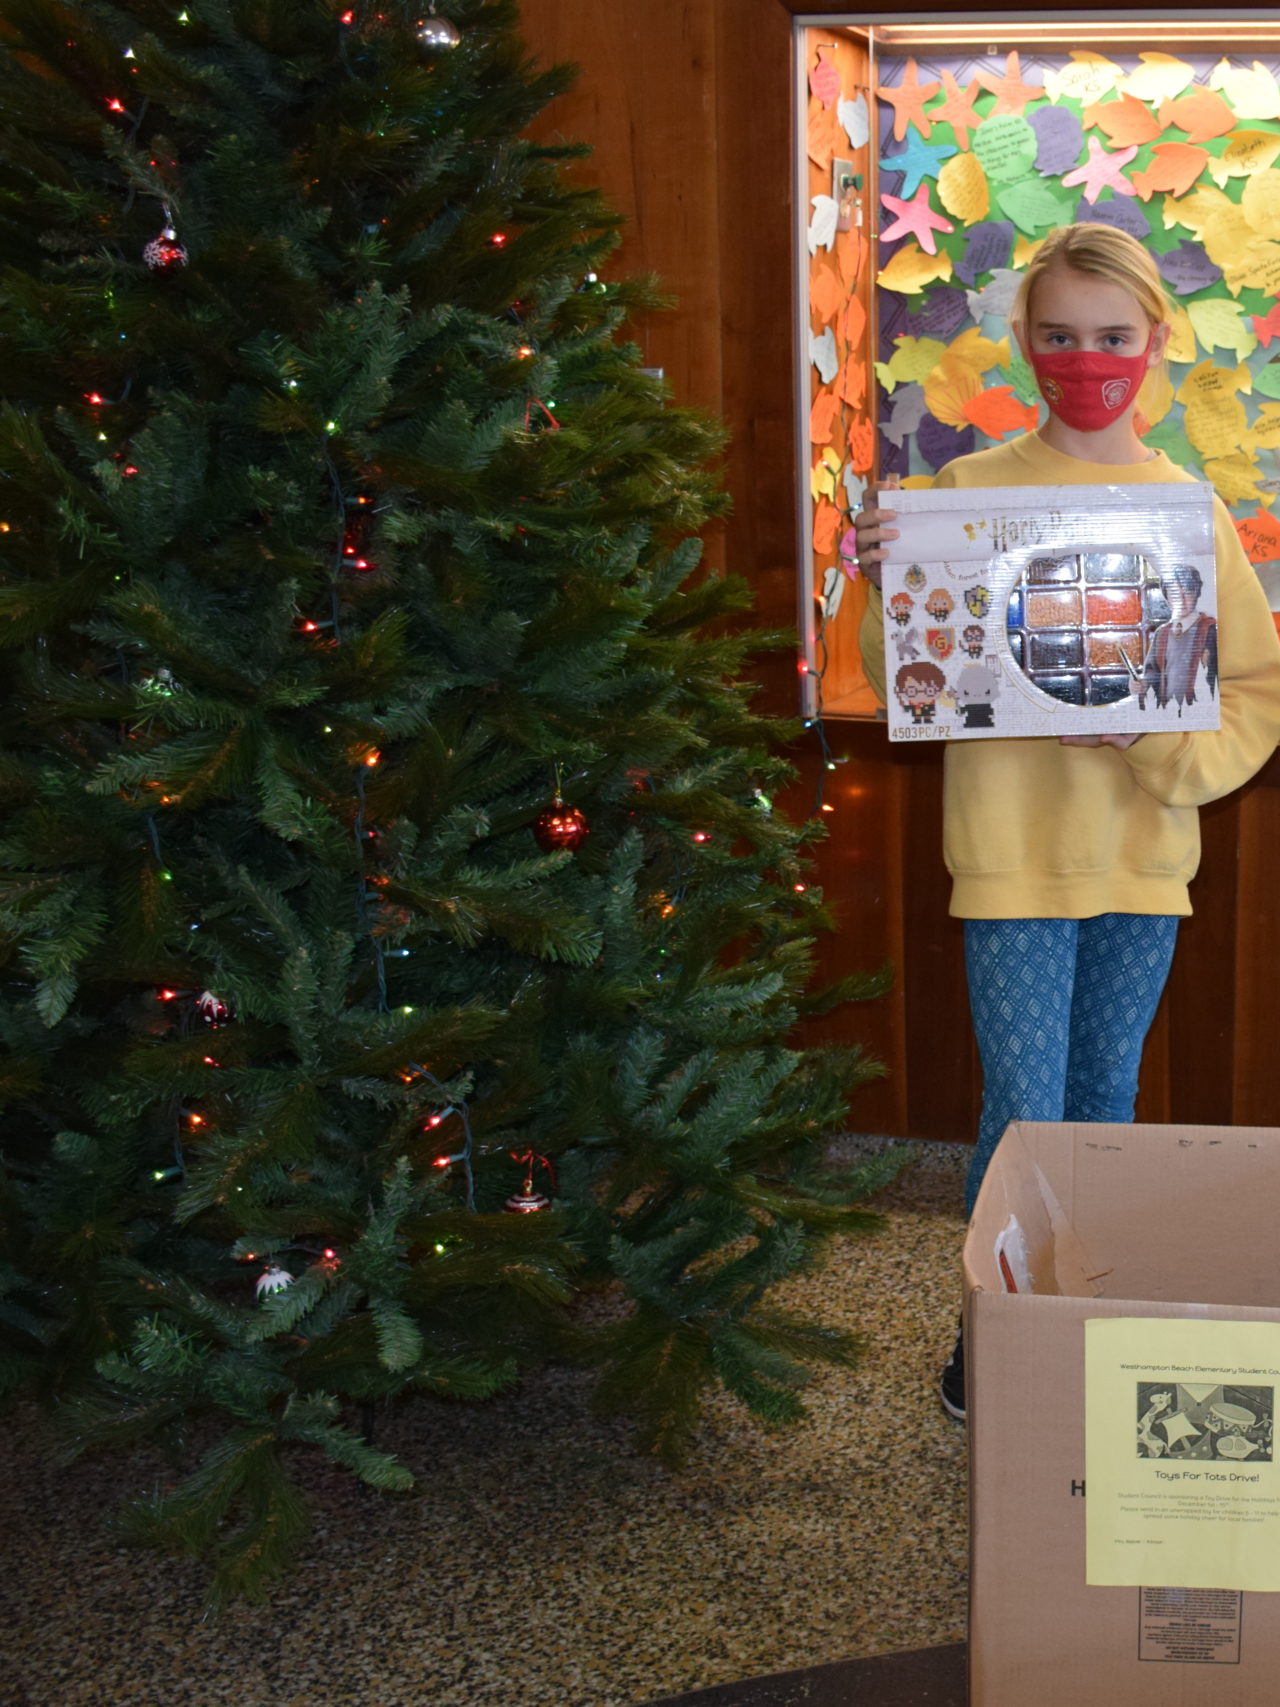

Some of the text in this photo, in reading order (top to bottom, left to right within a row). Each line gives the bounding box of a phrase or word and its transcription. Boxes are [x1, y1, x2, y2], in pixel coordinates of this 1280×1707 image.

[1236, 522, 1278, 548] Ariana
[1251, 542, 1269, 558] KS
[1119, 1363, 1171, 1373] Westhampton
[1171, 1365, 1195, 1373] Beach
[1194, 1365, 1238, 1375] Elementary
[1238, 1367, 1268, 1375] Student
[1155, 1470, 1261, 1483] Toys For Tots Drive!
